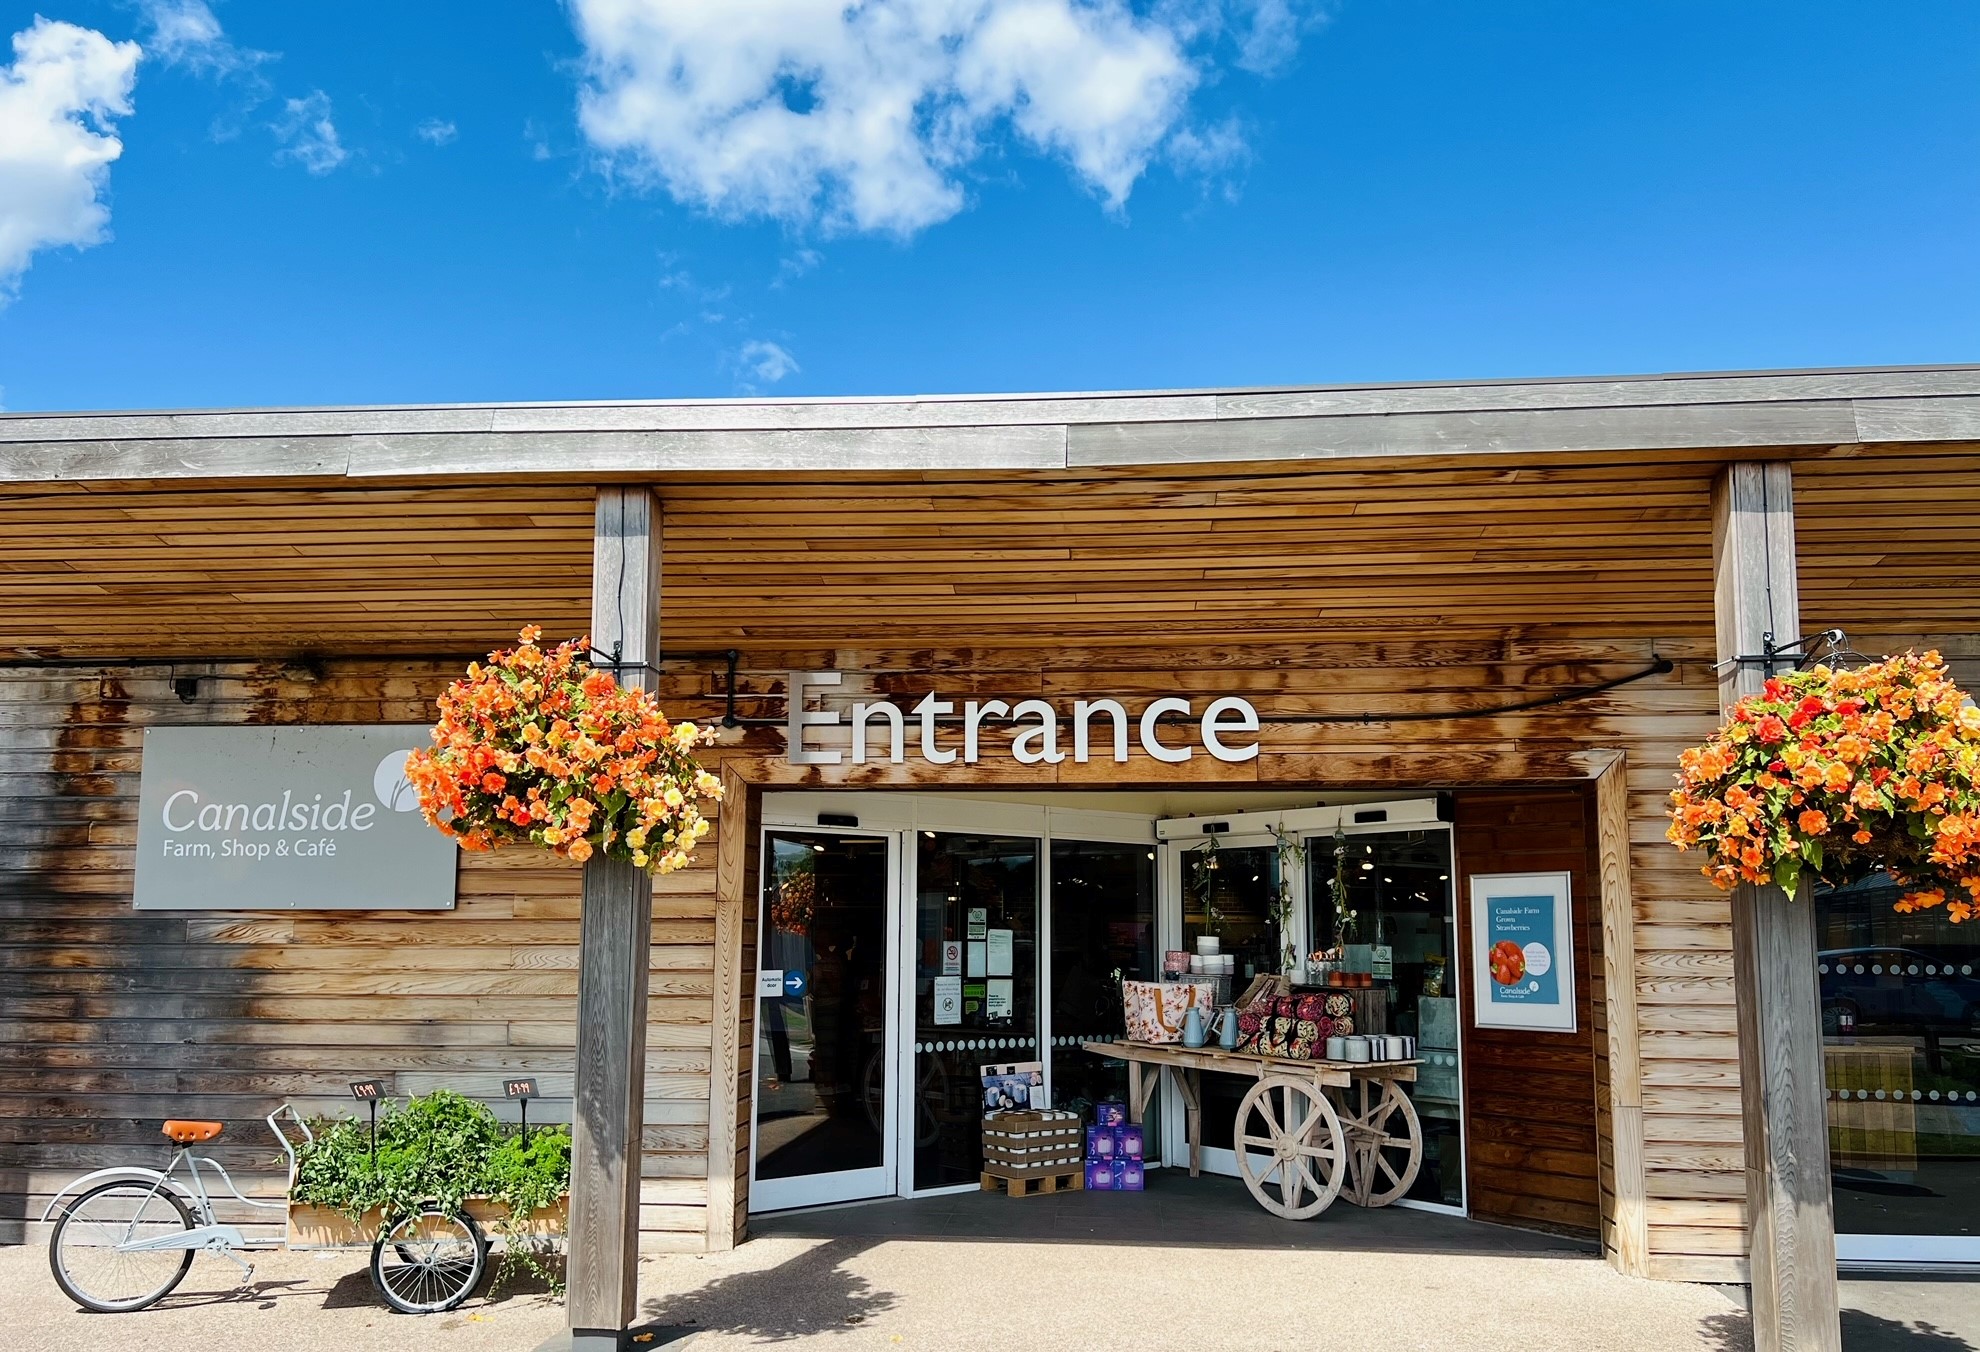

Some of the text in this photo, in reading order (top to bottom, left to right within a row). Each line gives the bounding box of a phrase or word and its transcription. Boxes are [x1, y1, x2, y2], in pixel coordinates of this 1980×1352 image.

[787, 671, 1260, 765] Entrance
[162, 789, 376, 832] Canalside
[163, 838, 336, 861] Farm, Shop & Café
[1496, 907, 1523, 915] Canalside
[1499, 986, 1531, 995] Canalside
